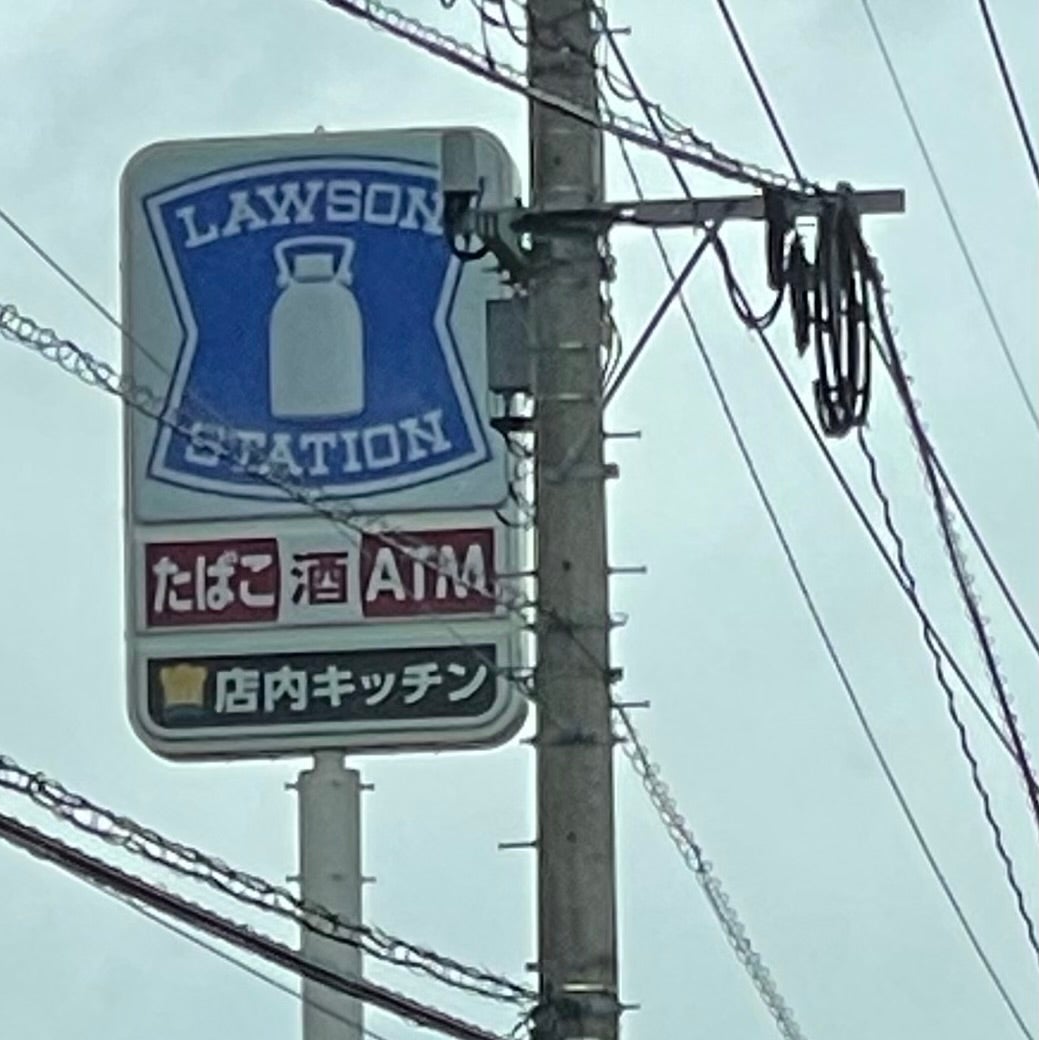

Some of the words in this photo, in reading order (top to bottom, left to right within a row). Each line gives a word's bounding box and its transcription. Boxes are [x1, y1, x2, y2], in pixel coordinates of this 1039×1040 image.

[176, 179, 444, 248] LAWSON
[184, 410, 452, 477] STATION
[153, 550, 275, 613] たばこ
[292, 552, 349, 606] 酒
[366, 543, 487, 602] ATM
[215, 661, 488, 713] 店内キッチン
